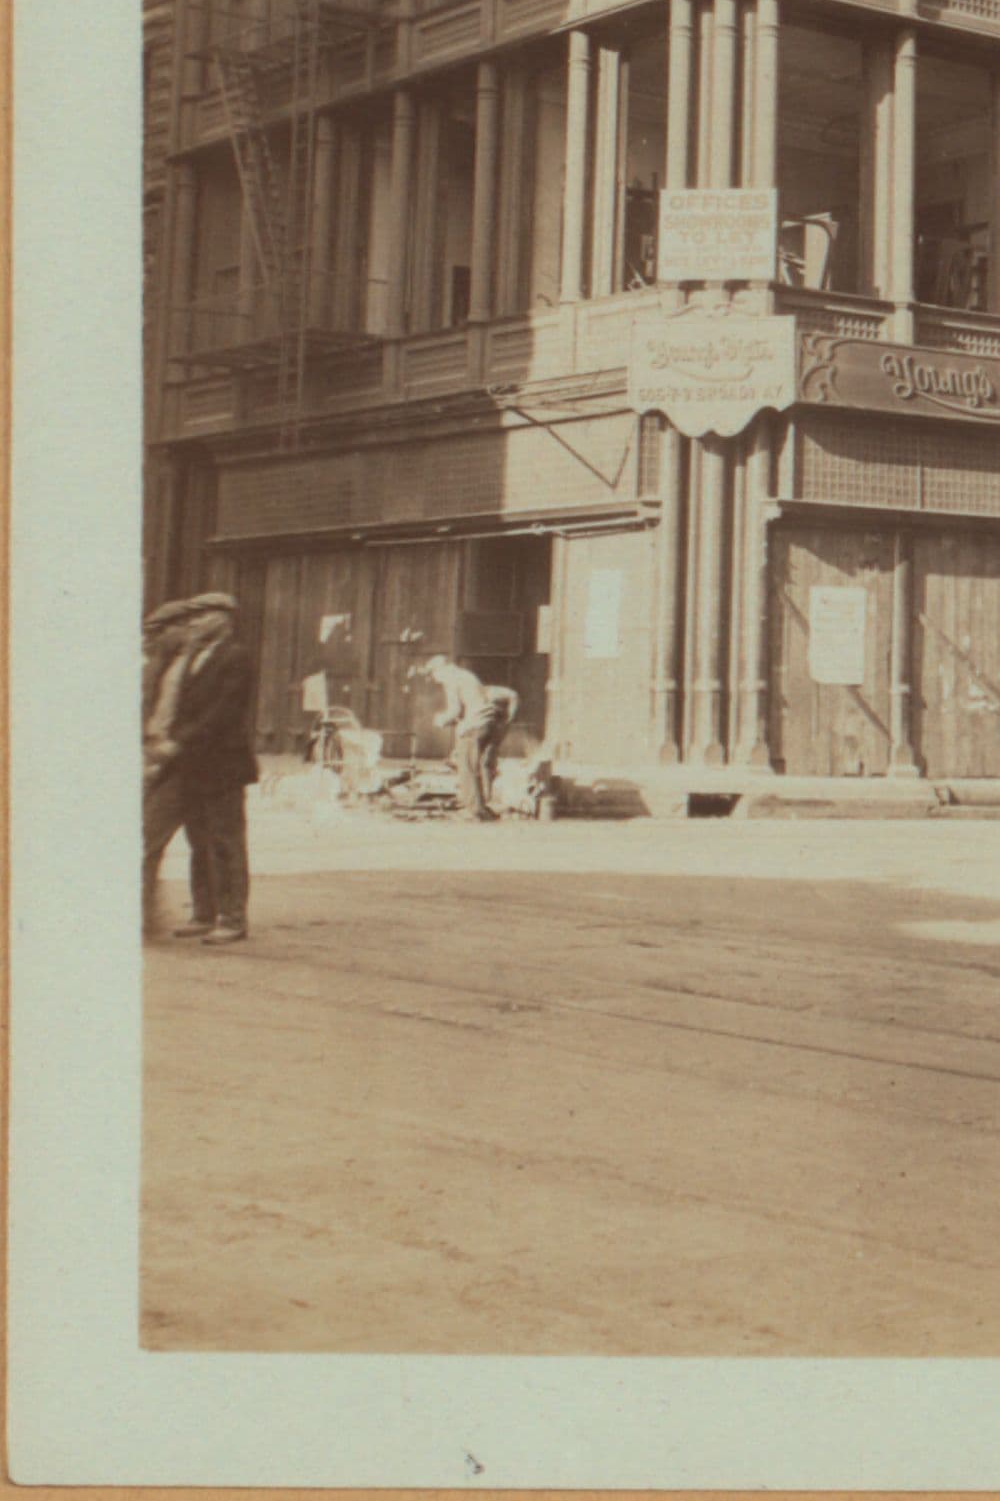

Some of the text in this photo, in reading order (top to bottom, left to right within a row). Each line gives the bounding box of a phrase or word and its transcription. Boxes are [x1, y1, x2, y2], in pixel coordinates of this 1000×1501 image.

[669, 193, 769, 211] OFFICES
[679, 230, 706, 244] TO
[881, 354, 995, 407] Young's
